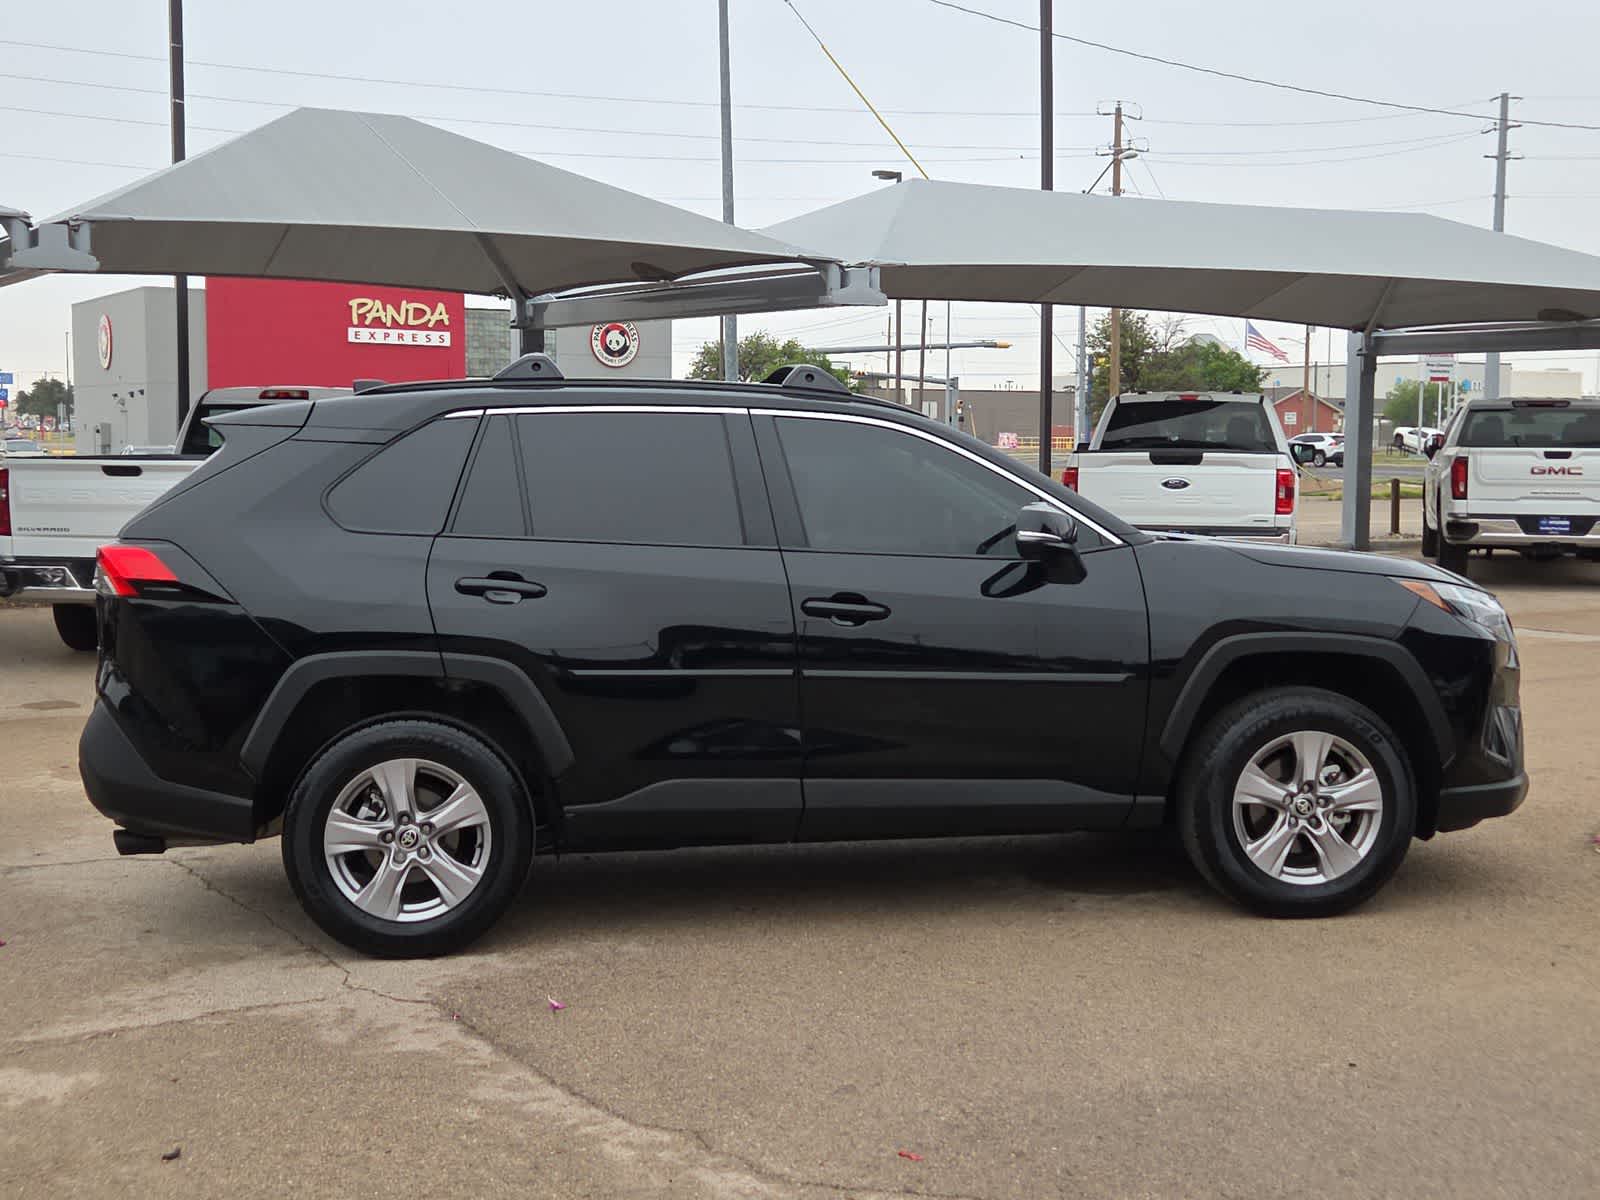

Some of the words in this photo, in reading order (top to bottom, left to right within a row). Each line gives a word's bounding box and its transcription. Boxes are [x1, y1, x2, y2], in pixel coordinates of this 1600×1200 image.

[348, 298, 449, 327] PANDA
[354, 330, 445, 344] EXPRESS
[1530, 466, 1583, 475] GMC
